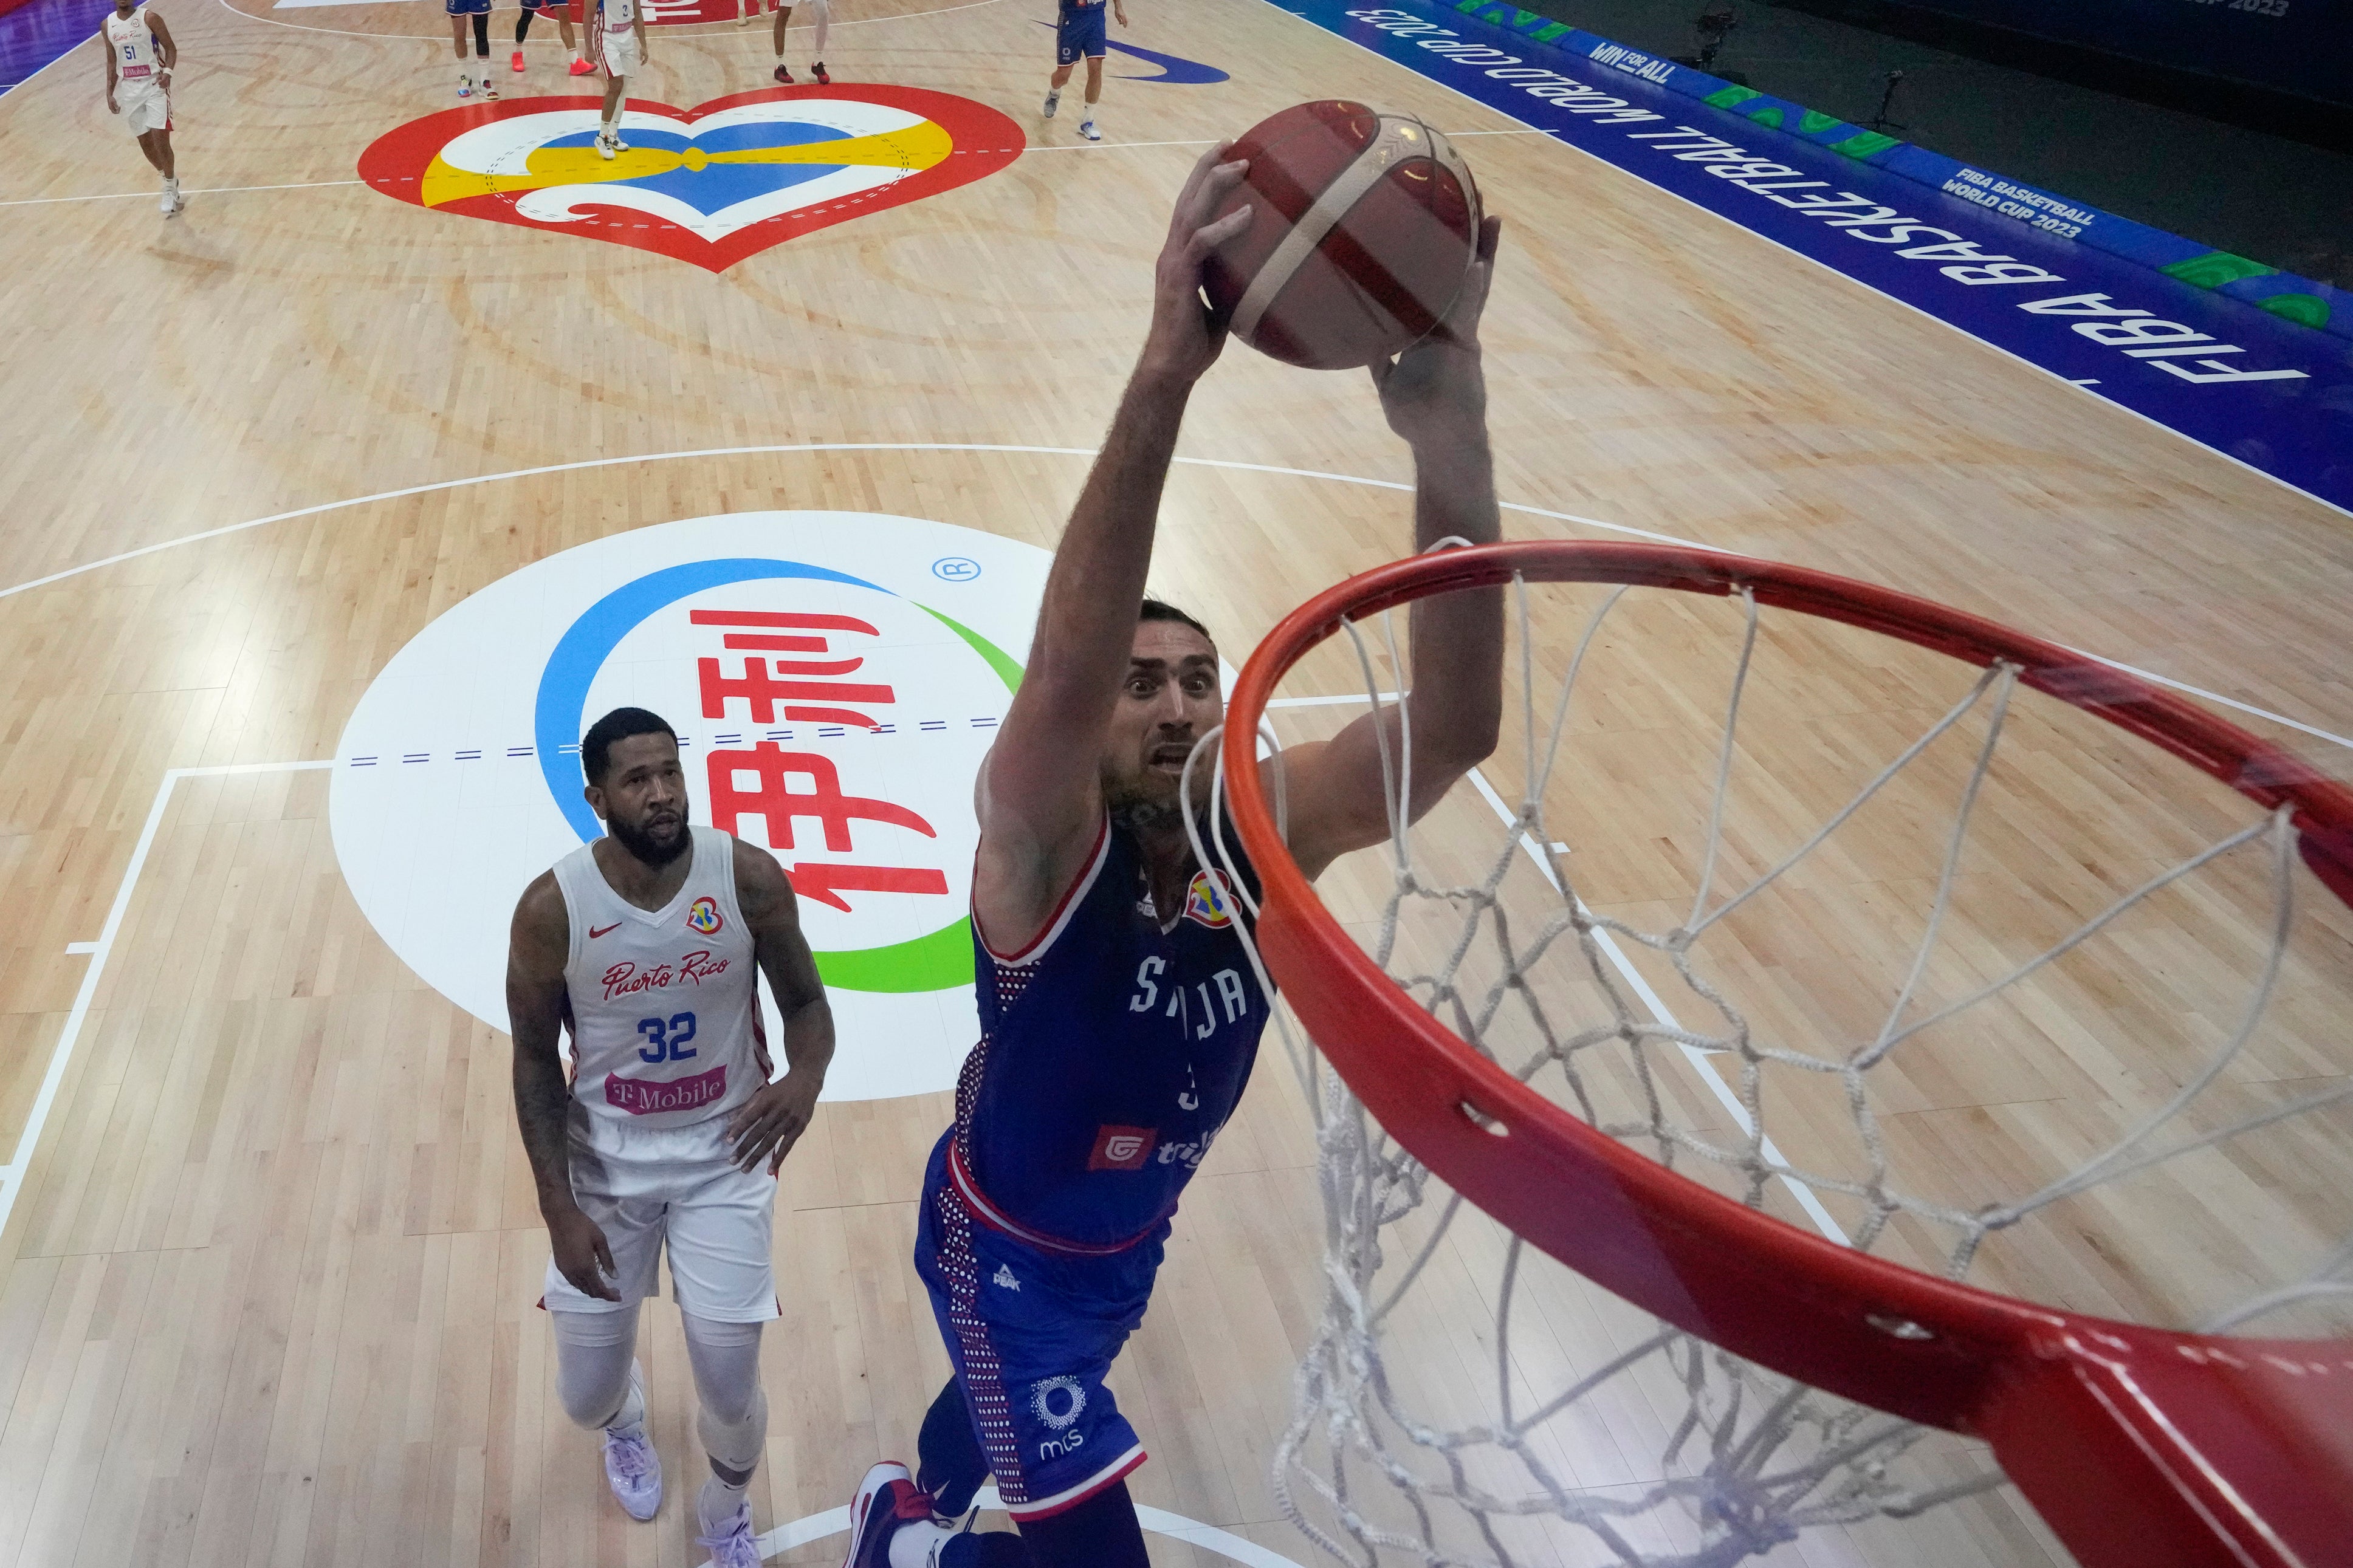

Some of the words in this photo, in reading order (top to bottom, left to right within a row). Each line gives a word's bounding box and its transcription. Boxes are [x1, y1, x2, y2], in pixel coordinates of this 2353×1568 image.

[1345, 9, 1460, 38] 2023
[123, 46, 136, 60] 51
[1417, 40, 1522, 65] CUP
[1589, 42, 1629, 66] WIN
[1623, 52, 1648, 67] FOR
[1635, 60, 1676, 84] ALL
[1484, 68, 1665, 124] WORLD
[1626, 126, 2066, 286] BASKETBALL
[1942, 179, 2000, 208] WORLD
[1997, 201, 2035, 219] CUP
[2030, 214, 2082, 239] 2023
[1956, 168, 1994, 188] FIBA
[1991, 181, 2095, 225] BASKETBALL
[2015, 292, 2312, 383] FIBA
[690, 609, 949, 913] 伊利
[602, 961, 674, 1001] Puerto
[679, 950, 732, 987] Rico
[637, 1011, 697, 1063] 32
[993, 1272, 1022, 1292] PEAK
